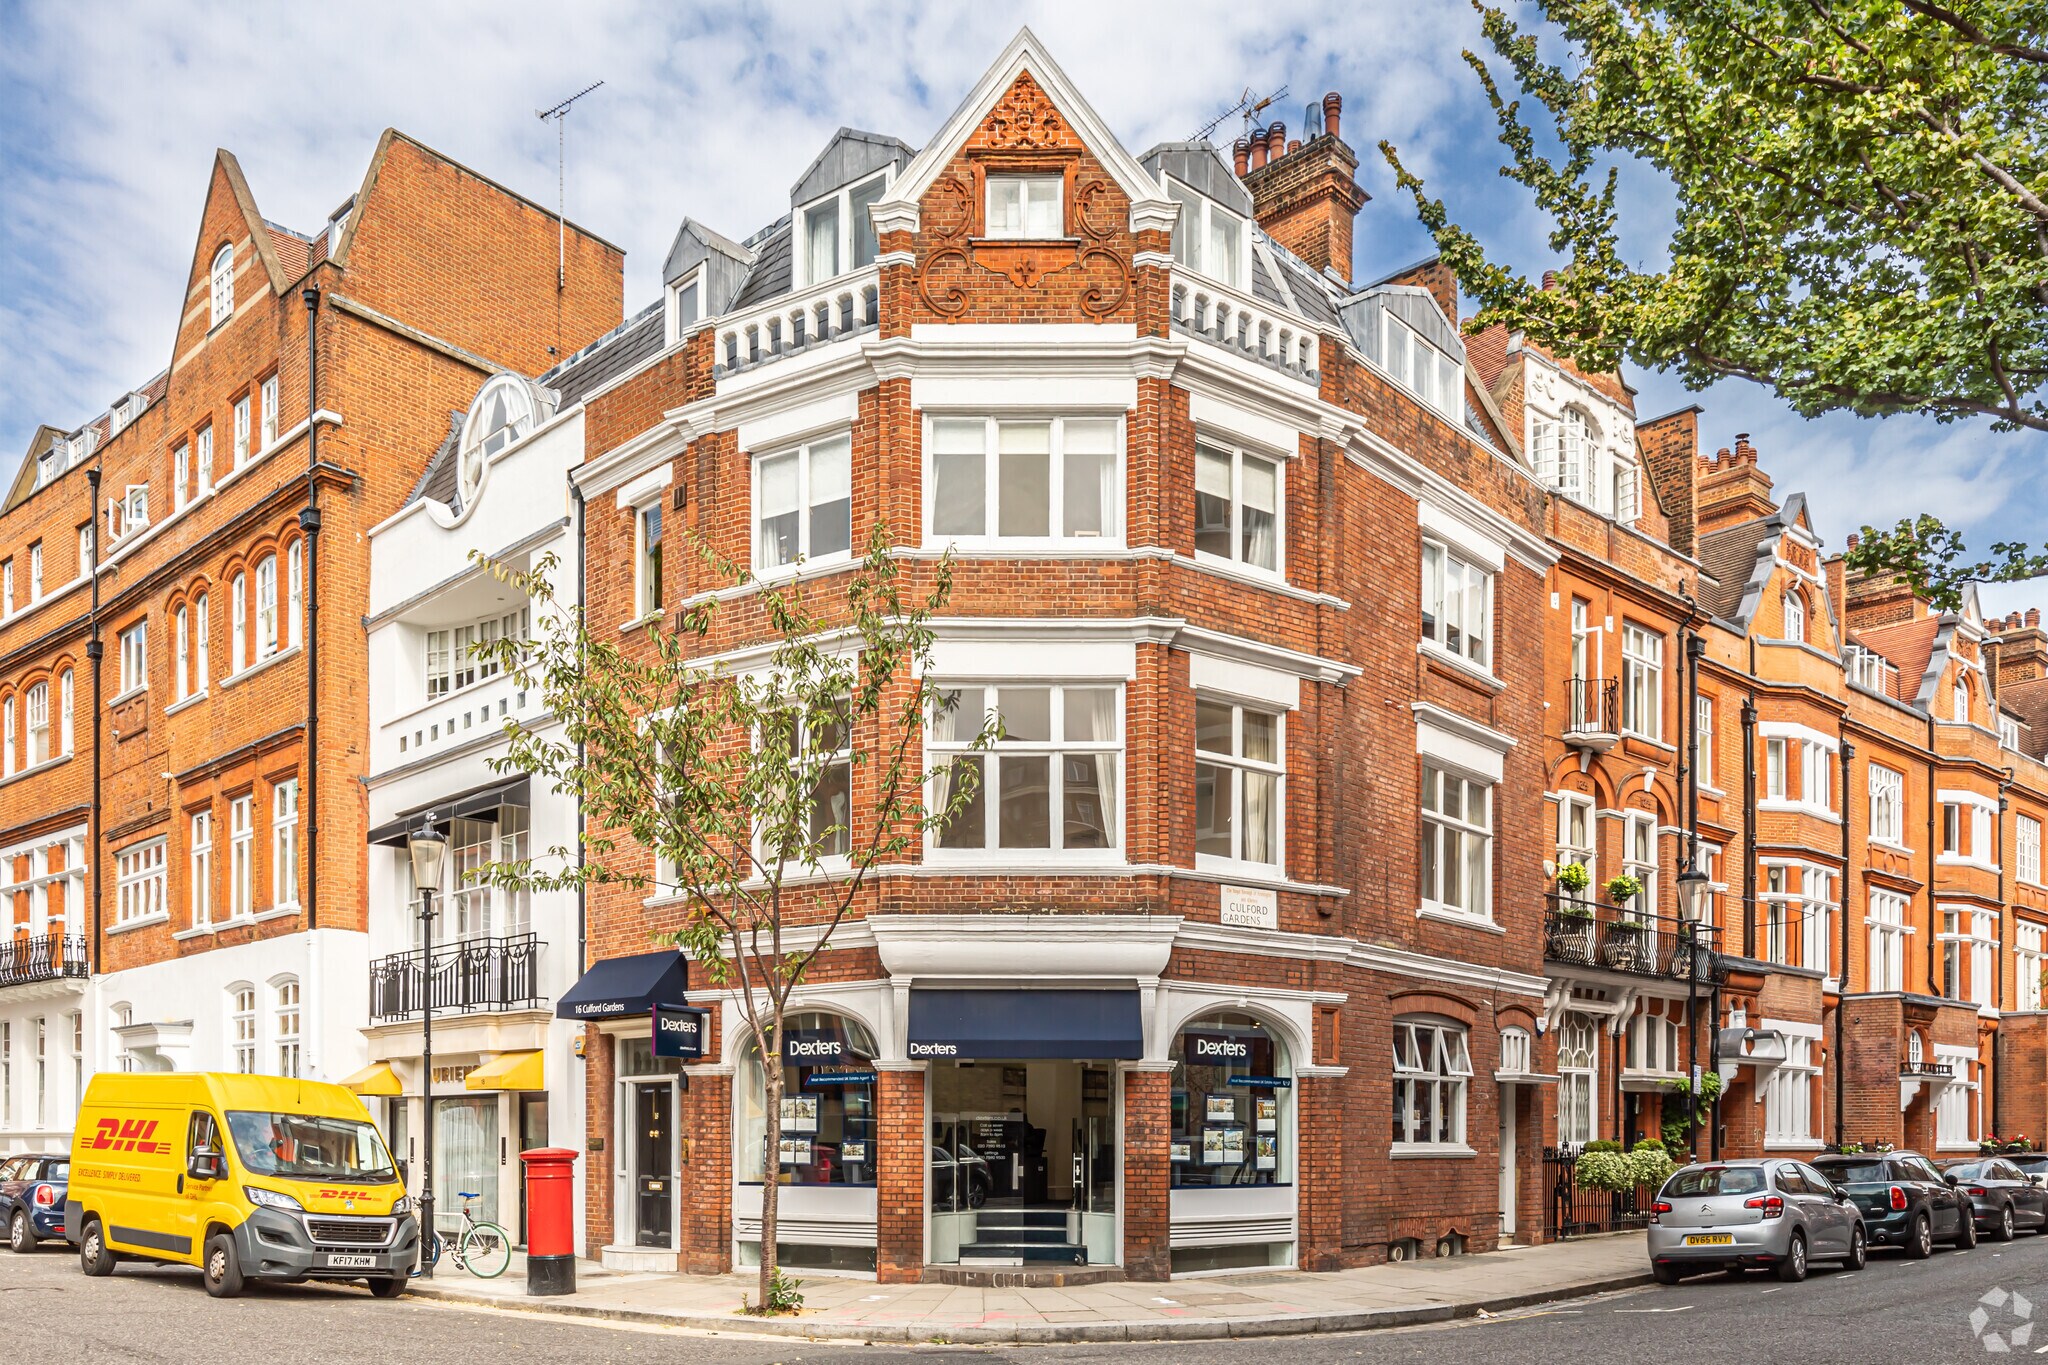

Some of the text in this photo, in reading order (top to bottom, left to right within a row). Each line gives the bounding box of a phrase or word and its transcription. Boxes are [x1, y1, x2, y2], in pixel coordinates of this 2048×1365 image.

[1230, 902, 1268, 915] CULFORD
[1222, 912, 1261, 925] GARDENS
[575, 1002, 624, 1014] 16 Culford Gardens
[661, 1018, 697, 1033] Dexters
[790, 1040, 842, 1056] Dexters
[910, 1043, 957, 1055] Dexters
[1197, 1039, 1247, 1056] Dexters
[92, 1118, 159, 1153] DHL
[319, 1190, 372, 1200] DHL
[1712, 1235, 1728, 1243] RVY
[333, 1256, 370, 1265] KF17 KHM
